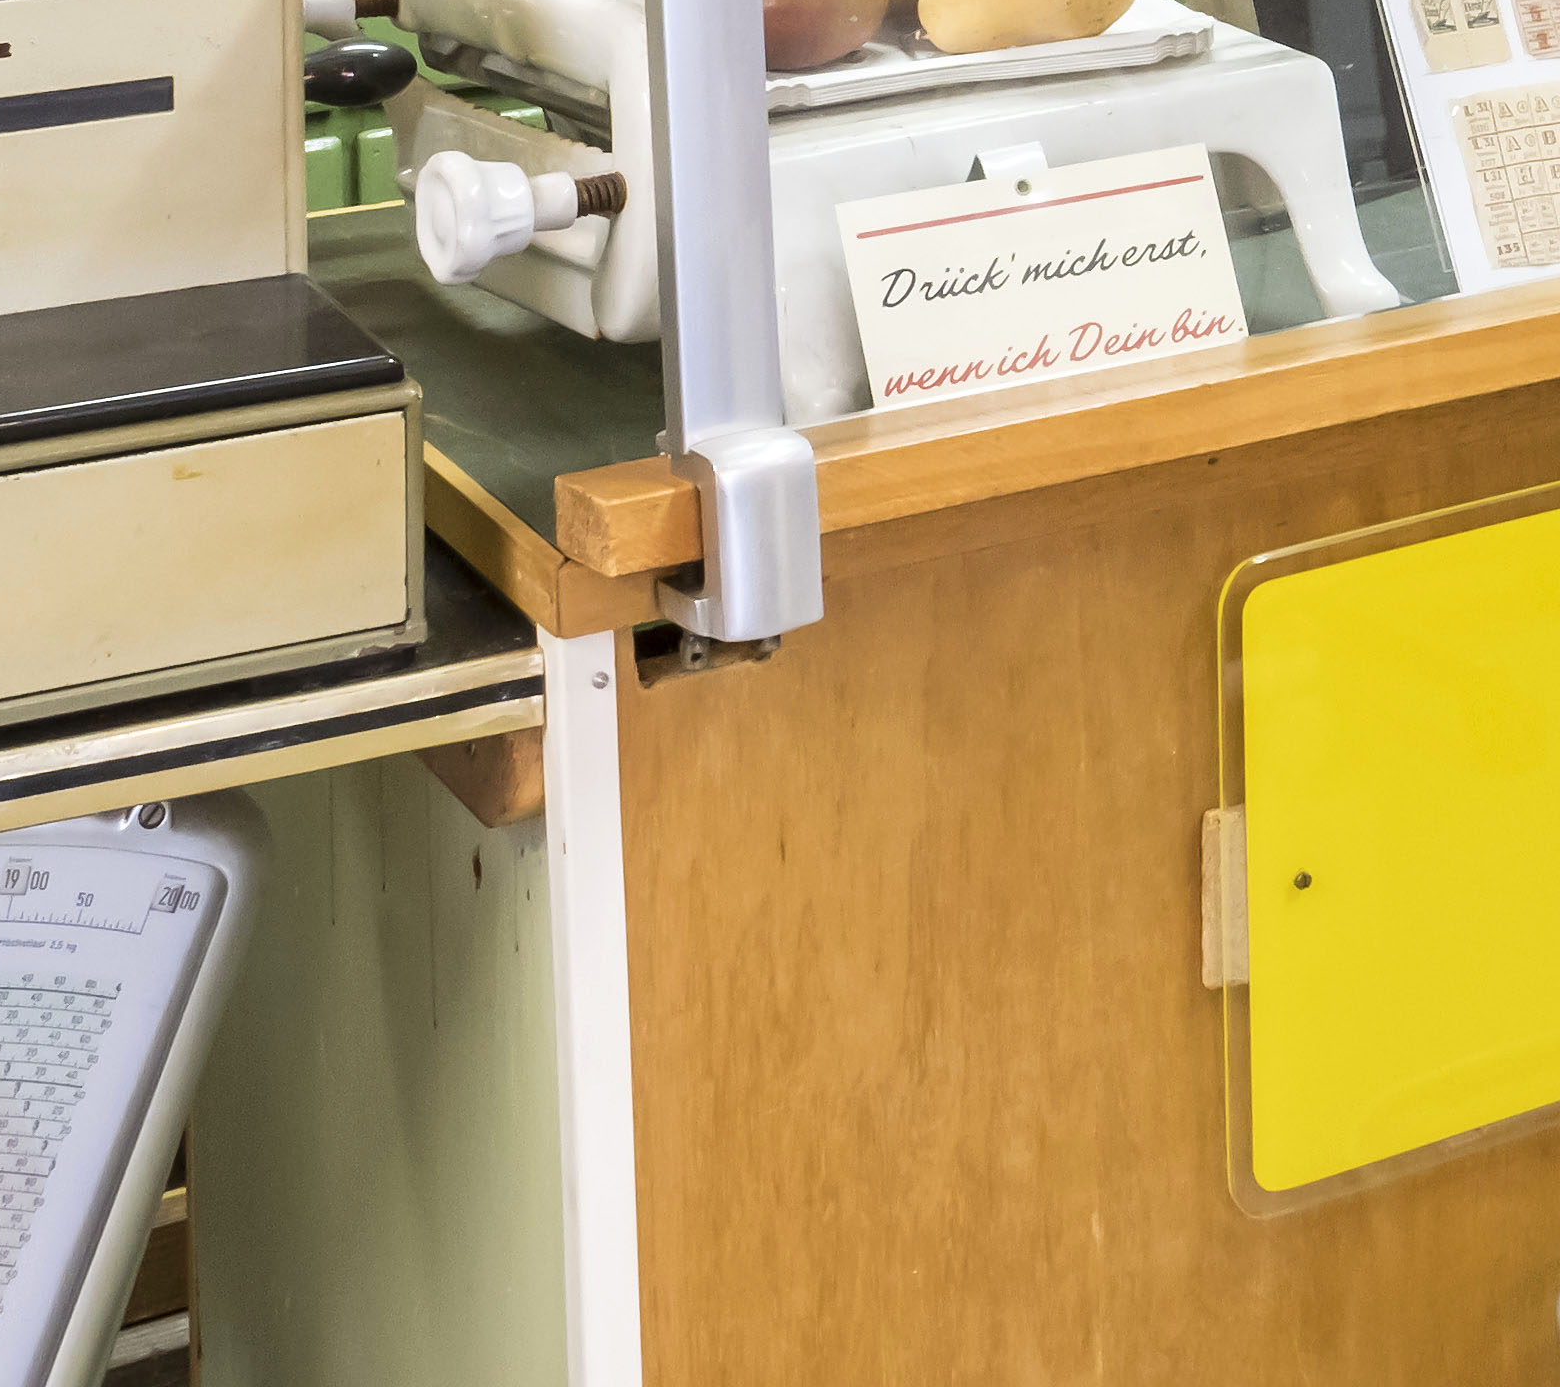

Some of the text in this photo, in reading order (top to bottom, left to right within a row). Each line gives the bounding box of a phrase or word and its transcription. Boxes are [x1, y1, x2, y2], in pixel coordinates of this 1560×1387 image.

[1022, 238, 1120, 285] mich
[1122, 230, 1207, 267] erst,
[884, 361, 995, 397] wenn
[998, 336, 1061, 377] ich
[1069, 322, 1169, 364] Dein
[76, 892, 94, 907] 50
